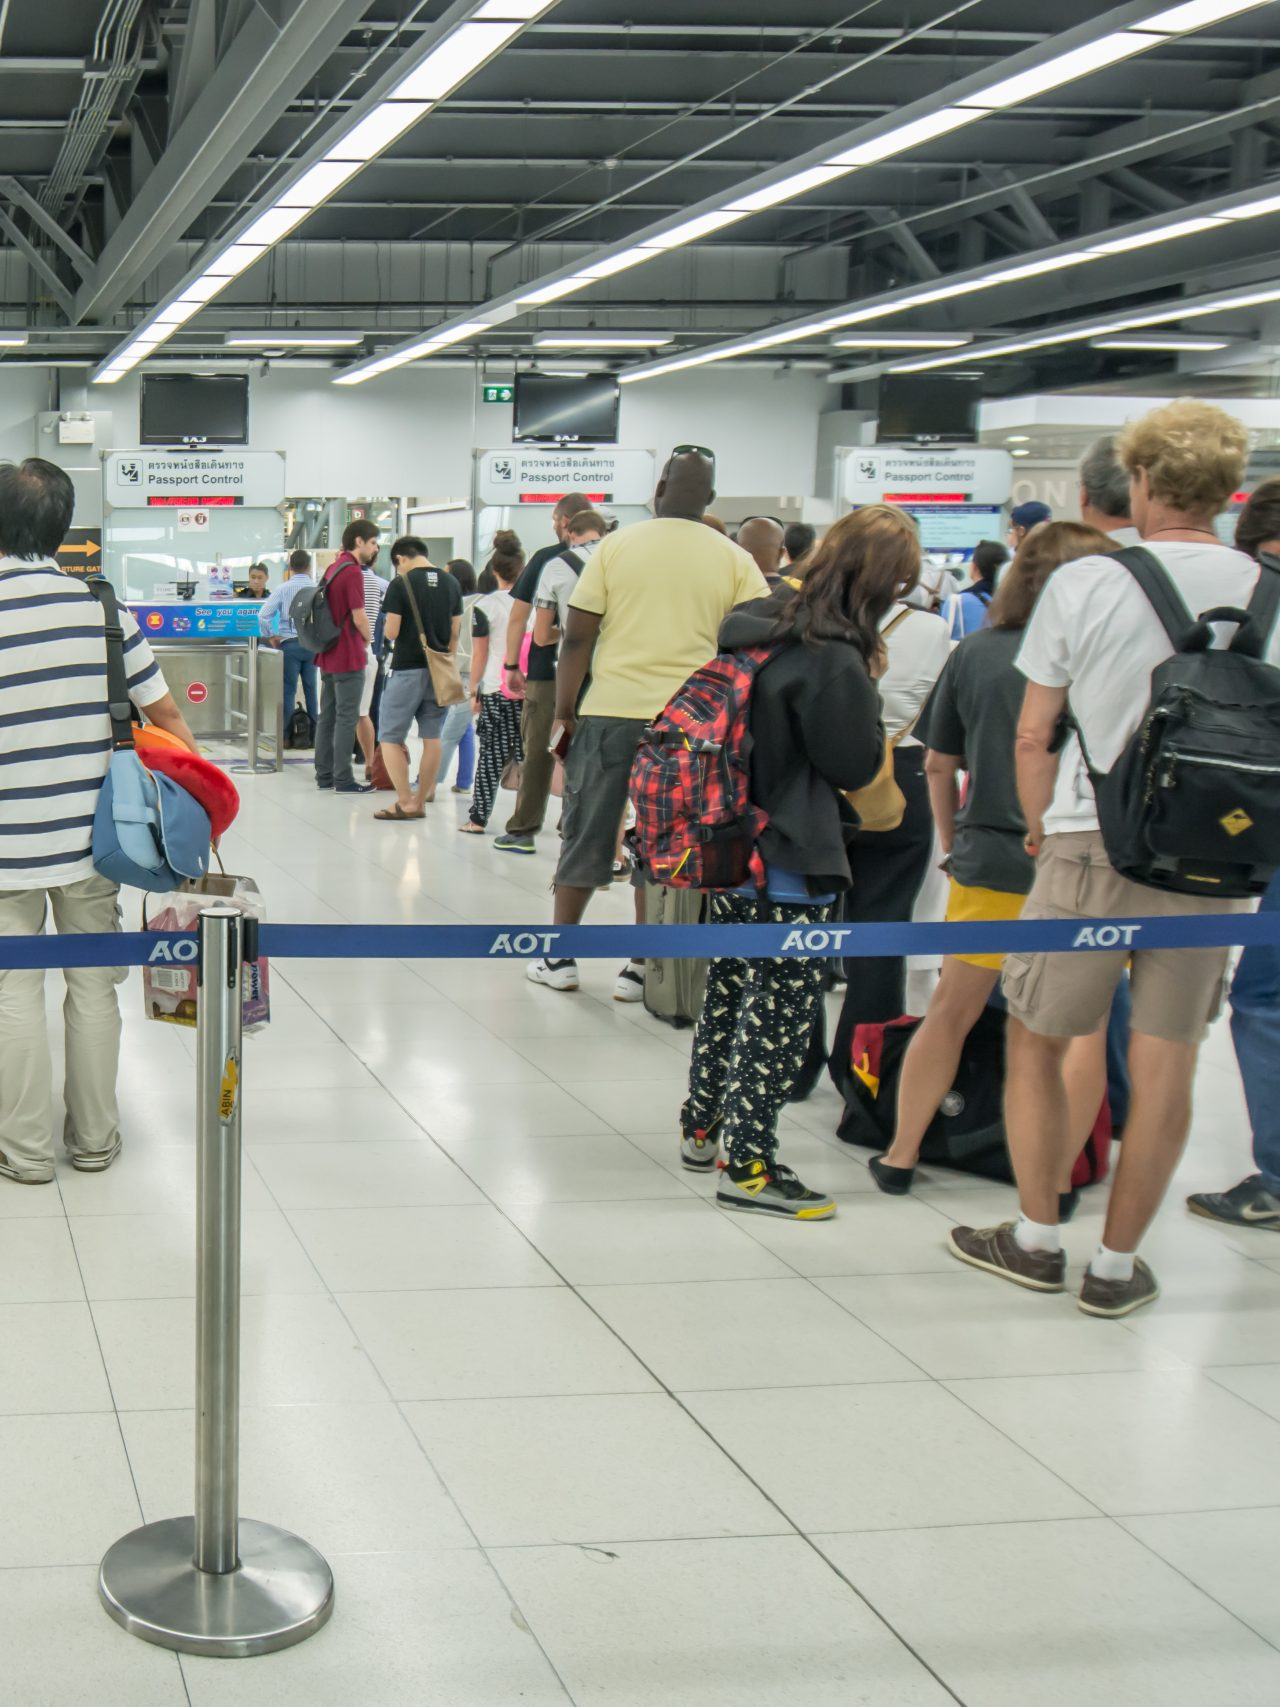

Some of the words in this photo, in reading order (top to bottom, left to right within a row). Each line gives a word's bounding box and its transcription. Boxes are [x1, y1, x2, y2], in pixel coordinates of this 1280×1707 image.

[148, 459, 244, 470] ตรวจหนังสือเดินทาง
[148, 474, 198, 486] Passport
[201, 474, 243, 485] Control
[521, 472, 570, 483] Passport
[573, 472, 614, 482] Control
[884, 472, 932, 482] Passport
[935, 472, 974, 481] Control
[195, 608, 212, 616] See
[217, 609, 233, 617] you
[781, 929, 853, 951] AOT
[1072, 925, 1143, 947] AOT
[488, 932, 561, 954] AOT
[147, 939, 200, 962] AO
